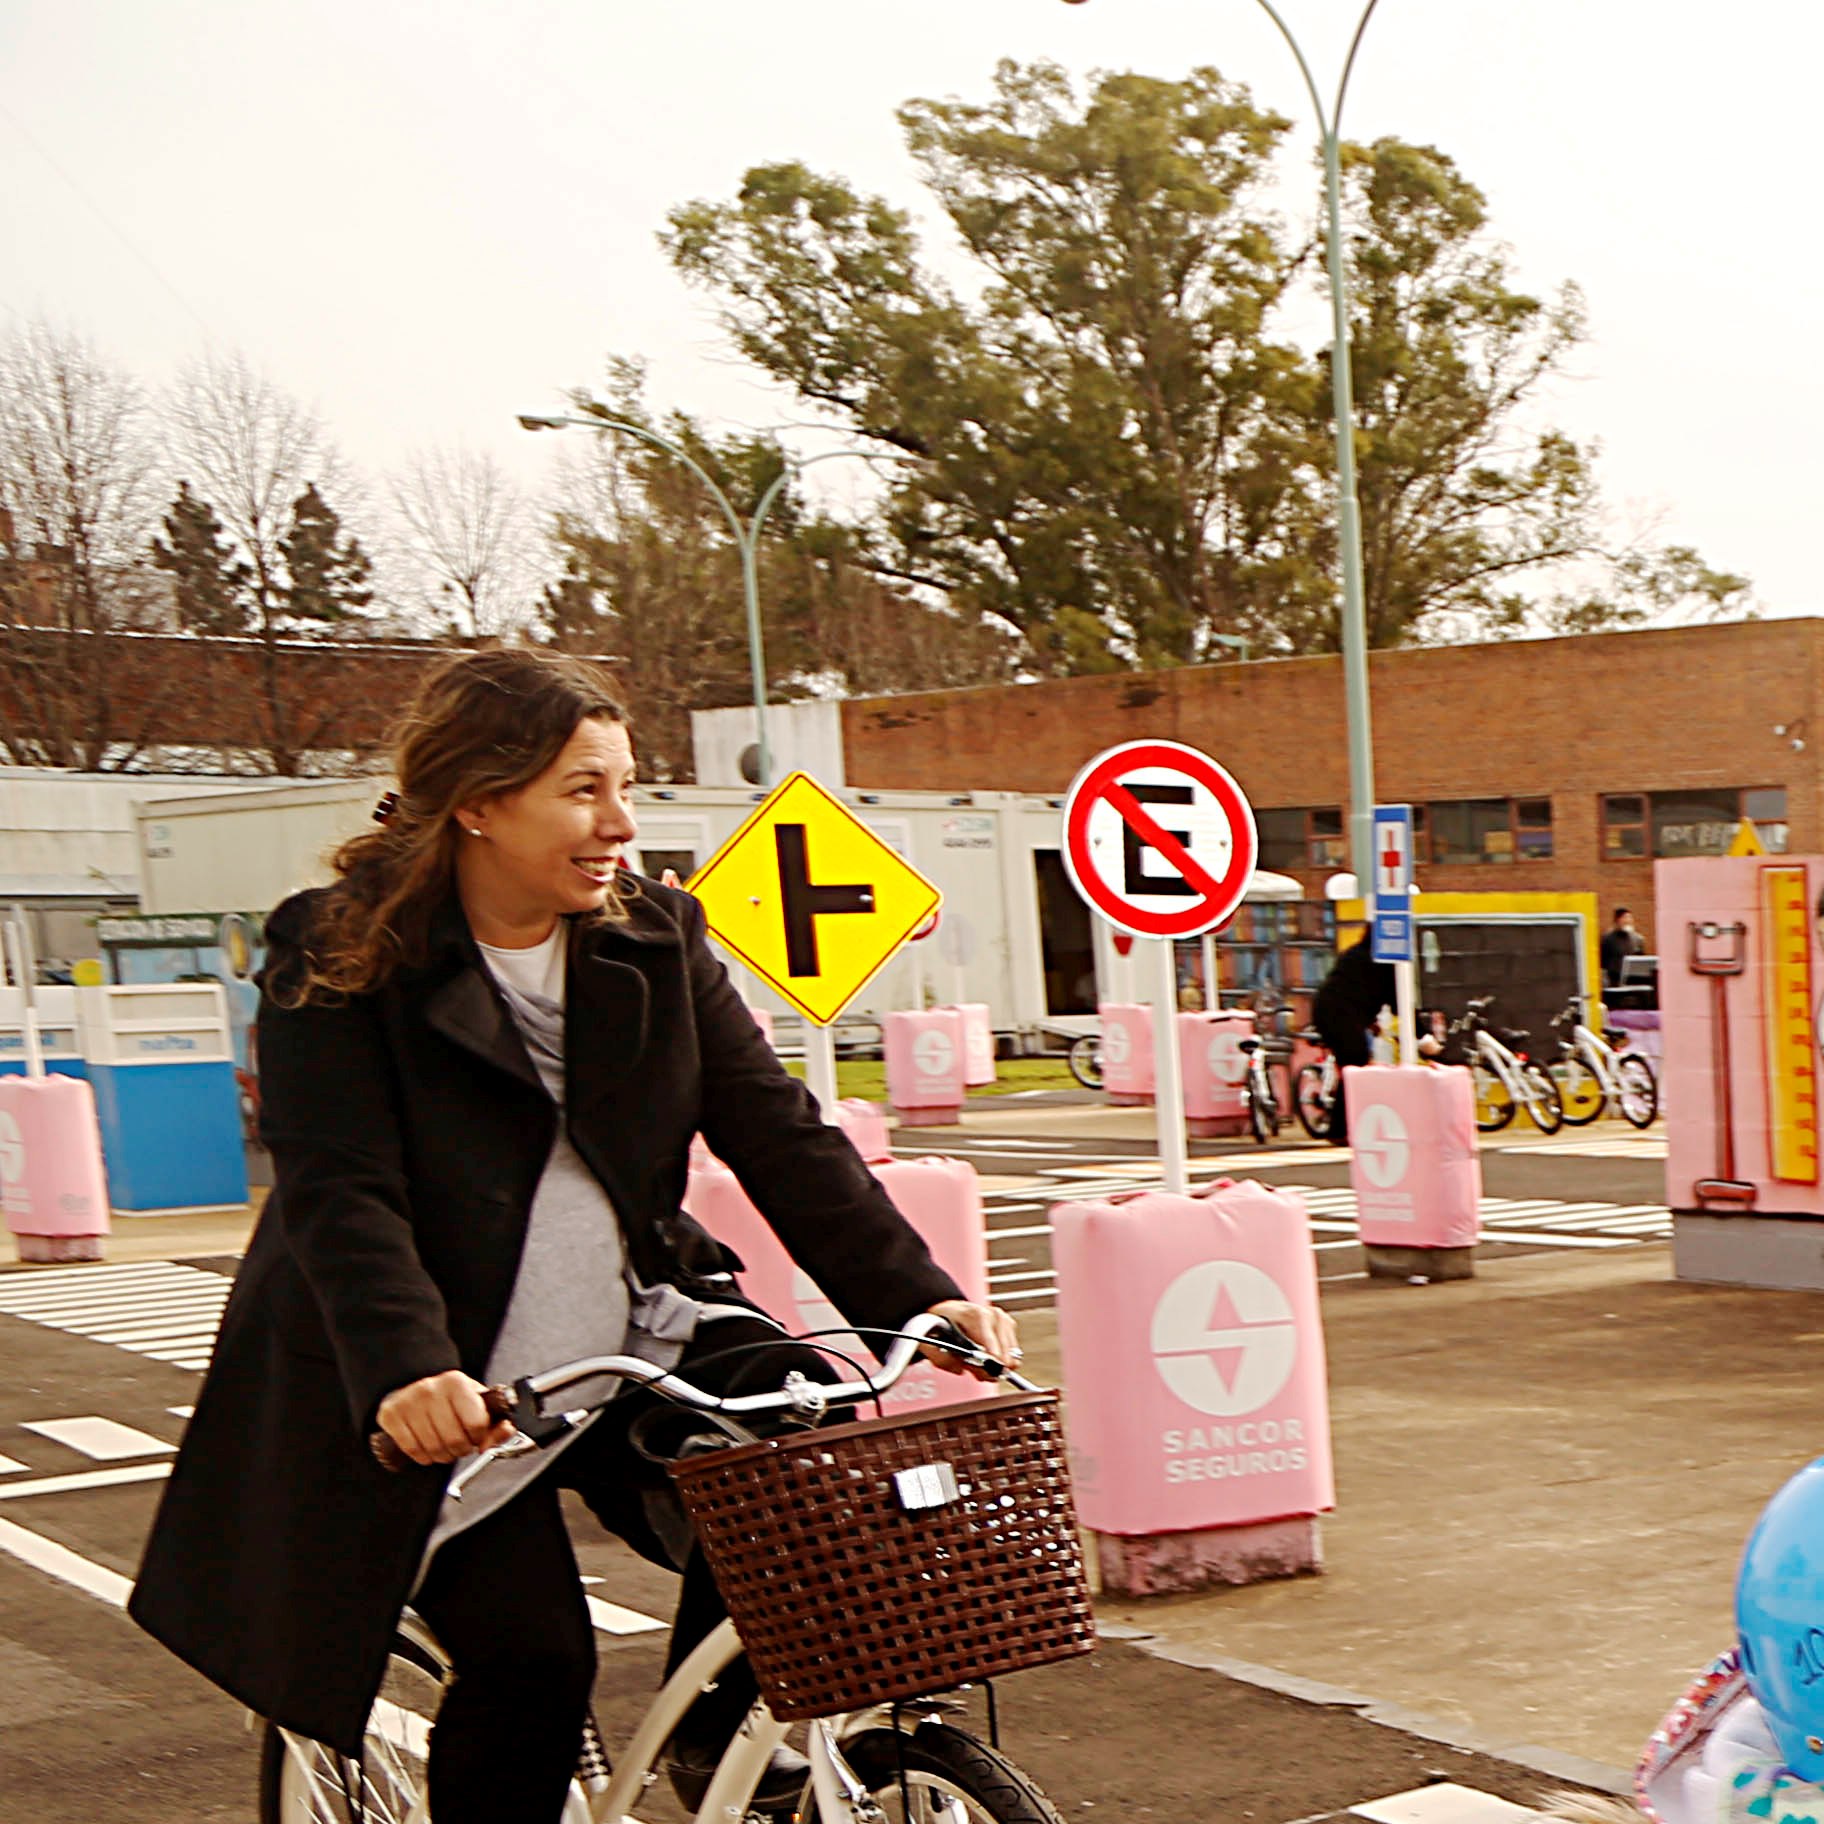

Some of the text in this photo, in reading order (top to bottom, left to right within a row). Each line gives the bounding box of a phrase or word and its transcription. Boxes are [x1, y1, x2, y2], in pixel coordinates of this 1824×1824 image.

[1122, 783, 1195, 896] E
[1162, 1418, 1305, 1453] SANCOR
[1165, 1448, 1309, 1483] SEGUROS
